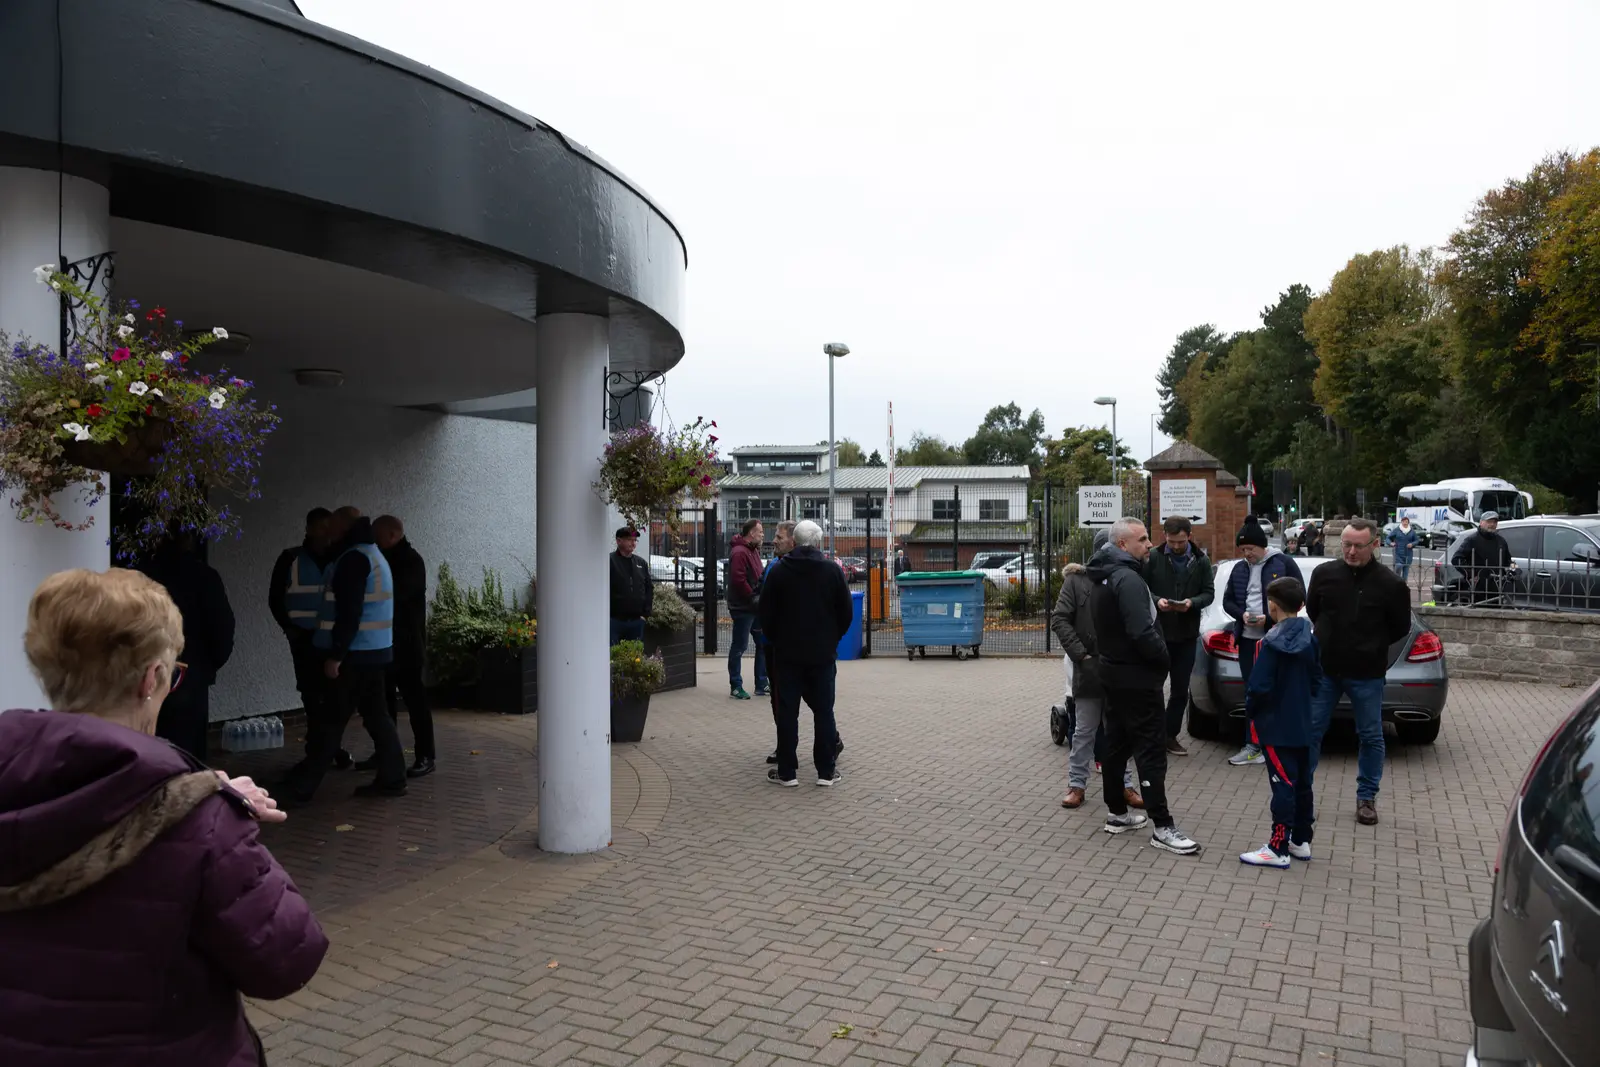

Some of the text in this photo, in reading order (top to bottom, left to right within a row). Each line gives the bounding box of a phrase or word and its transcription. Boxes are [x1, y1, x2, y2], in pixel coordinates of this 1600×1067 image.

[1093, 490, 1117, 498] John's
[1092, 510, 1108, 518] Hall
[827, 524, 852, 532] Kvin's
